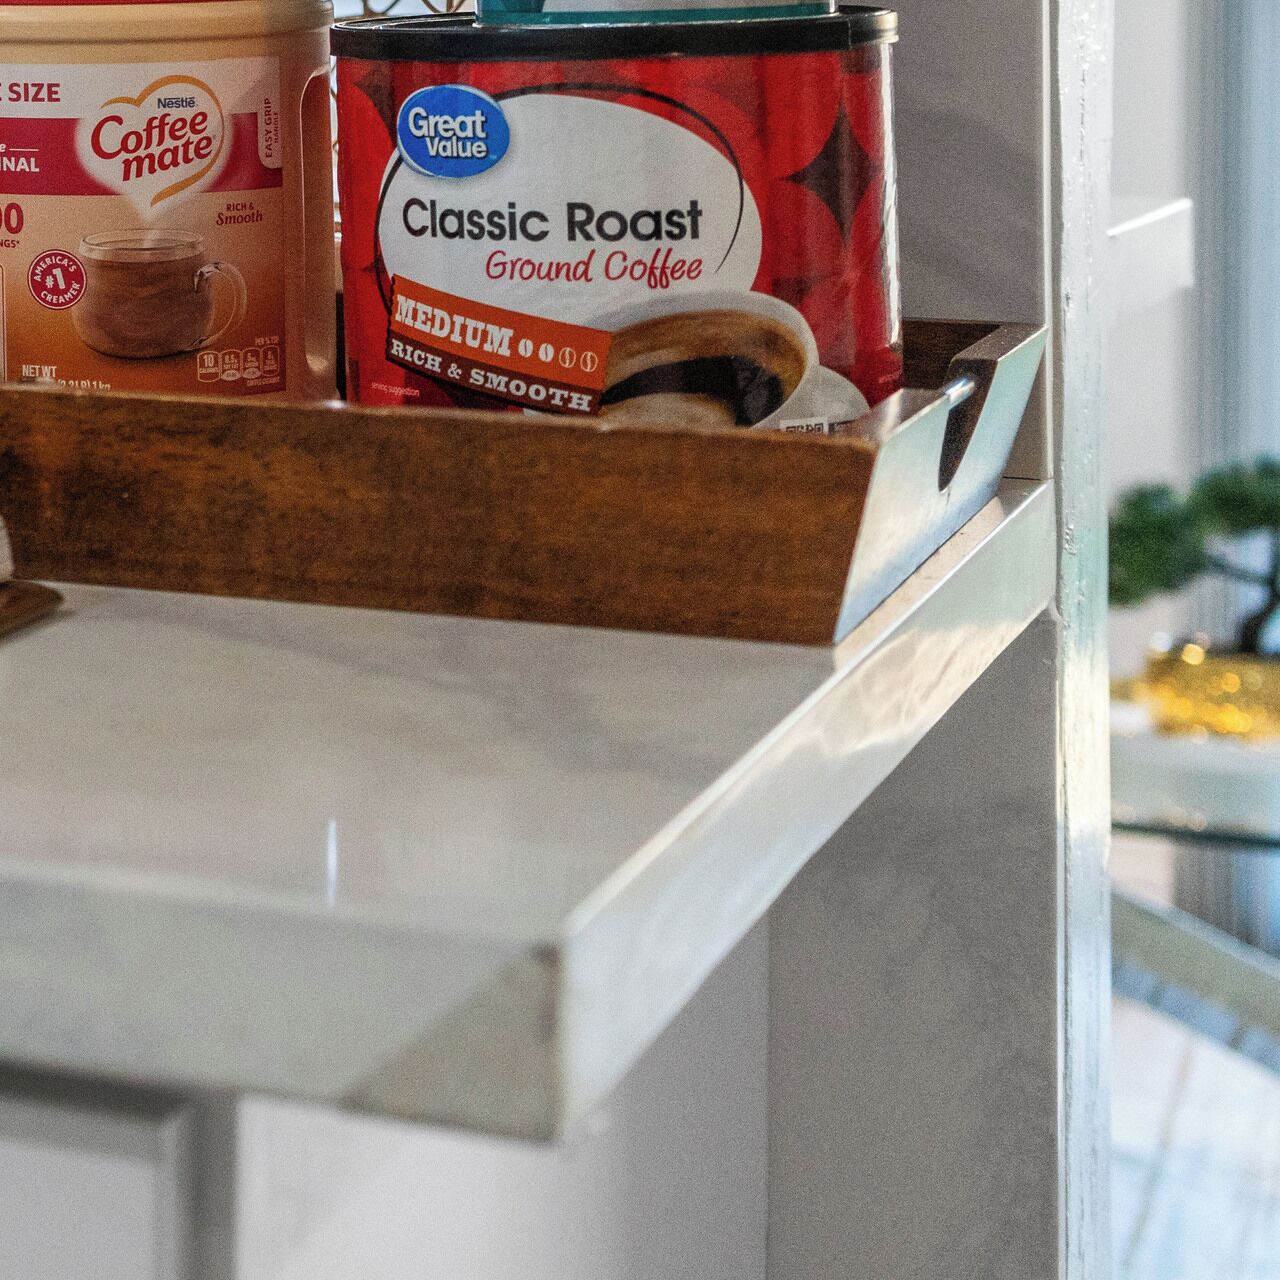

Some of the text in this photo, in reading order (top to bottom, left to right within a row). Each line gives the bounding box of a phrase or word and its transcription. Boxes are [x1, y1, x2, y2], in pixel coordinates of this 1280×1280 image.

[8, 82, 61, 103] SIZE
[91, 111, 208, 160] Coffee
[264, 97, 273, 158] EASY GRIP
[408, 107, 486, 139] Great
[122, 135, 213, 182] mate
[425, 136, 487, 159] Value
[216, 210, 263, 226] Smooth
[226, 203, 247, 212] RICH
[402, 197, 703, 242] Classic Roast
[33, 256, 77, 282] AMERICA'S
[45, 268, 66, 290] #1
[485, 248, 703, 289] Ground Coffee
[395, 294, 513, 357] MEDIUM
[22, 365, 57, 378] NET WT
[203, 354, 214, 367] 10
[391, 338, 592, 412] RICH & SMOOTH
